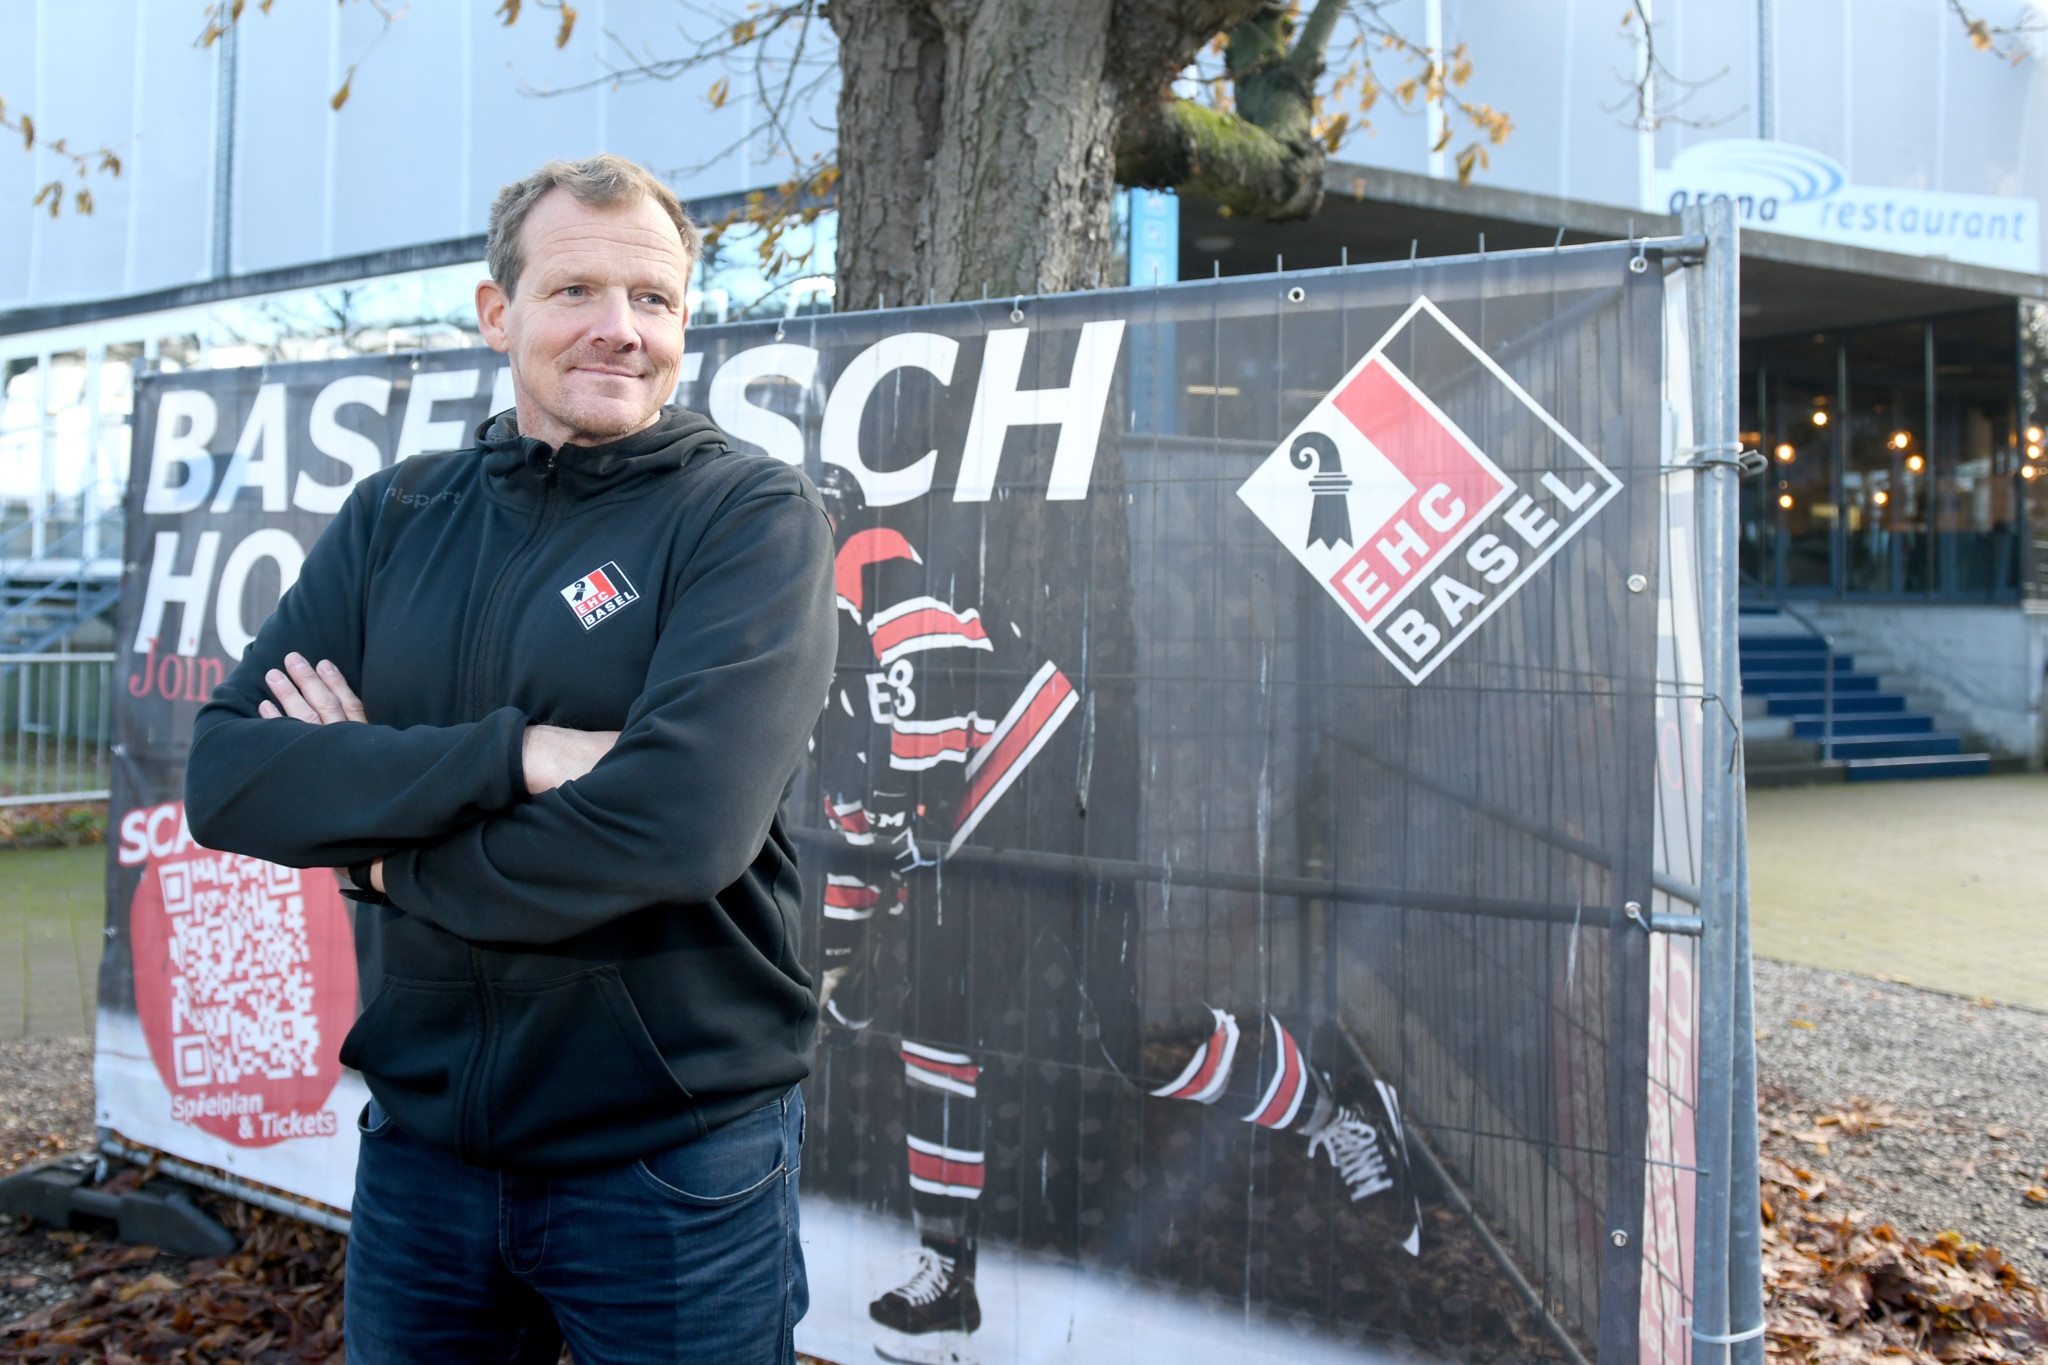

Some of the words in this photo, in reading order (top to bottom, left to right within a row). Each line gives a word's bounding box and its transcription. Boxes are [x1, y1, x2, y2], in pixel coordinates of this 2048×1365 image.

[1821, 198, 2027, 243] restaurant
[1341, 482, 1466, 612] EHC
[1385, 470, 1597, 664] BASEL
[576, 591, 609, 614] EHC
[584, 591, 635, 626] BASEL
[119, 804, 205, 864] SCA
[171, 1090, 264, 1124] Spielplan
[238, 1115, 255, 1140] &
[258, 1109, 335, 1139] Tickets
